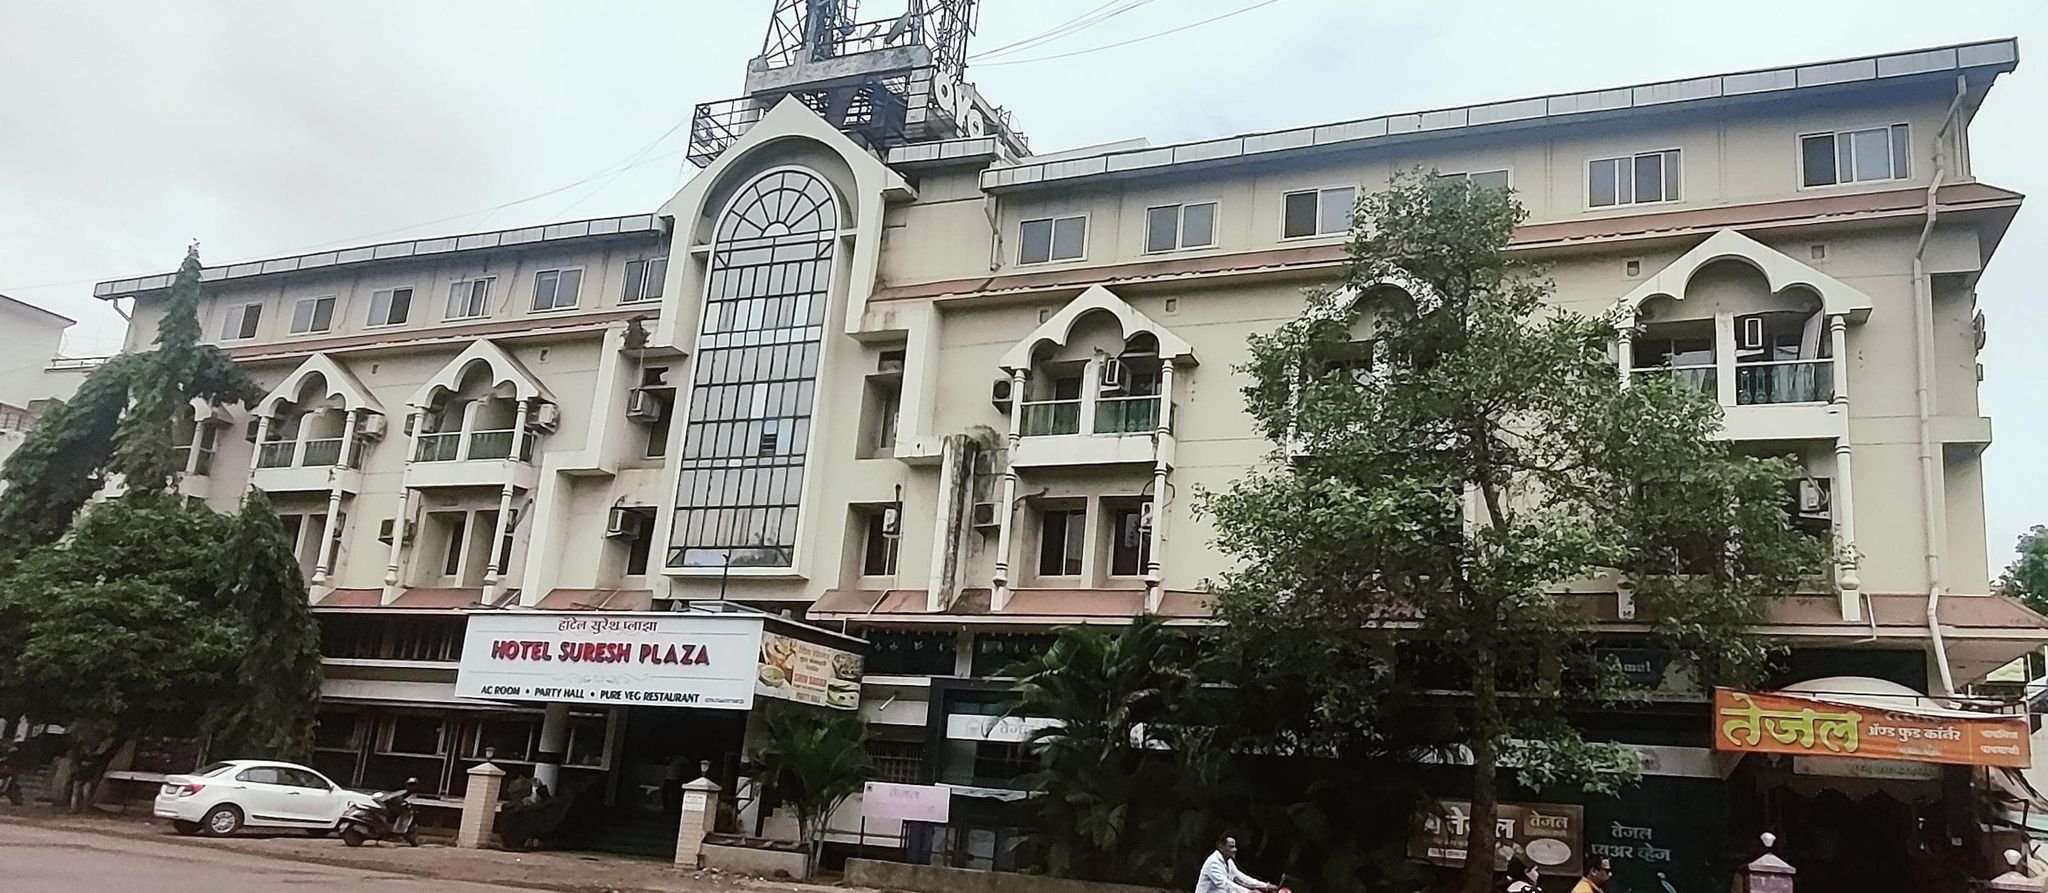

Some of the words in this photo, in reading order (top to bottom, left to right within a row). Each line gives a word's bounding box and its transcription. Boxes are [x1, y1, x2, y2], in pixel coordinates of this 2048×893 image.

[558, 616, 586, 632] हॉटेल
[591, 616, 620, 635] सुरेश
[623, 620, 658, 633] प्लाझा
[491, 639, 552, 662] HOTEL
[557, 641, 633, 664] SURESH
[638, 643, 711, 666] PLAZA
[481, 685, 494, 695] AC
[494, 685, 521, 696] ROOM
[534, 687, 562, 698] PARTY
[563, 689, 584, 699] HALL
[600, 689, 622, 700] PURE
[624, 690, 642, 701] VEG
[643, 691, 700, 704] RESTAURANT
[1719, 692, 1864, 754] तेजल
[1898, 727, 1921, 742] फुड
[1530, 810, 1569, 829] तेजल
[1610, 820, 1653, 841] तेजल
